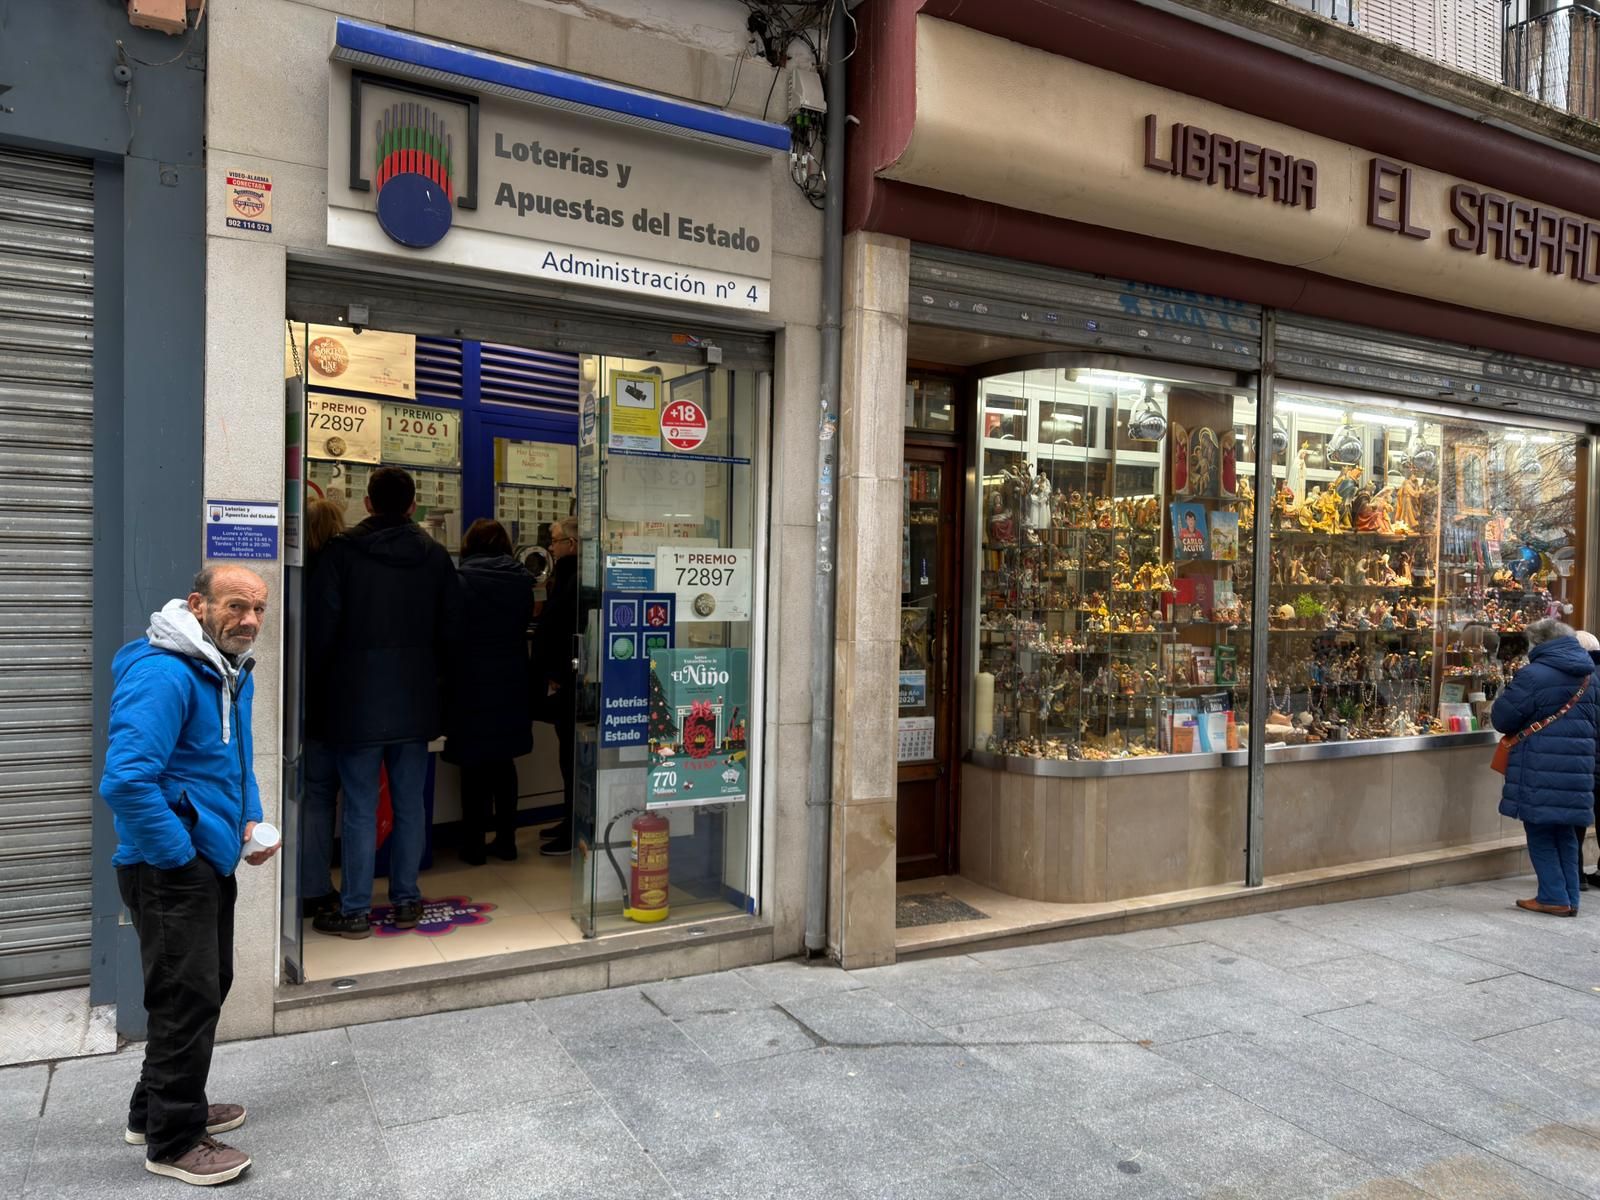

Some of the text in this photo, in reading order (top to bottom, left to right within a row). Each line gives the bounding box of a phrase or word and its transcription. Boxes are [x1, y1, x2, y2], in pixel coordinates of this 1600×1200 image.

[494, 133, 631, 189] Loterías y
[1144, 113, 1317, 209] LIBRERIA
[1367, 156, 1431, 240] EL
[232, 179, 266, 191] CONECTADA
[228, 218, 270, 231] 902 114 573
[494, 182, 761, 254] Apuestas del Estado
[541, 251, 758, 304] Administración nº 4
[321, 401, 367, 416] PREMIO
[402, 408, 443, 422] PREMIO
[670, 405, 696, 422] +18
[308, 413, 365, 433] 72897
[688, 553, 737, 565] PREMIO
[675, 567, 735, 587] 72897
[682, 664, 729, 687] Niño
[606, 696, 648, 709] Loterías
[605, 729, 641, 742] Estado
[653, 771, 677, 787] 770
